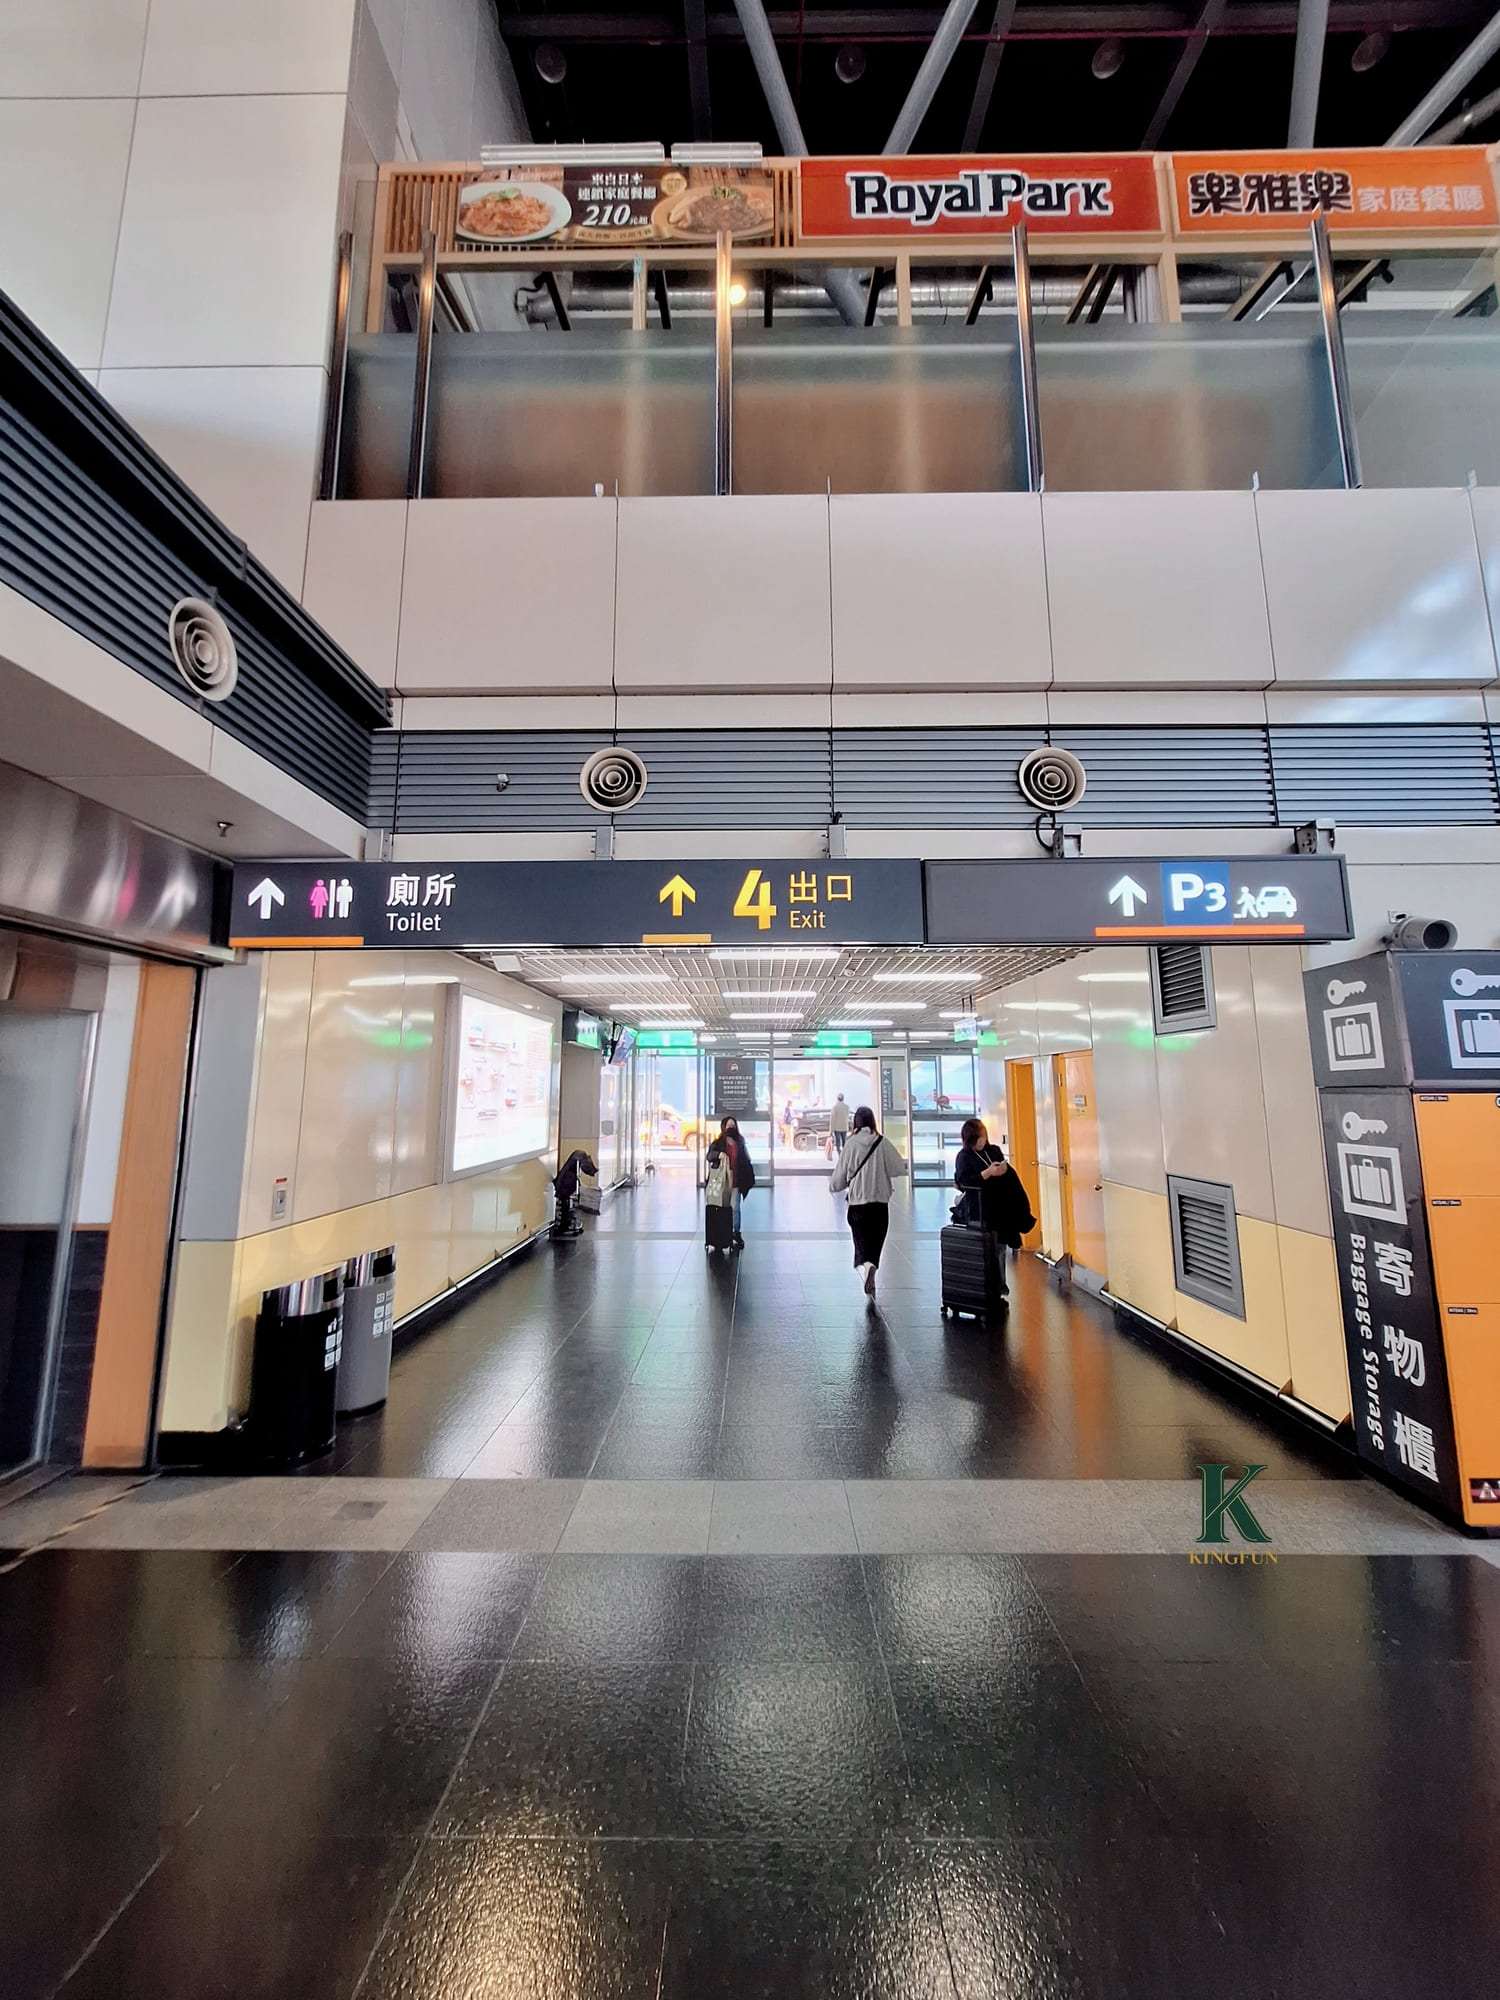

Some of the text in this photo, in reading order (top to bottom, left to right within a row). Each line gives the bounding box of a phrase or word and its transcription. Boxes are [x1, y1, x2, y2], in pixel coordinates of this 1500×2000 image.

[848, 172, 1111, 222] Royal Park
[1189, 170, 1484, 215] 樂雅樂 家庭餐廳
[386, 873, 457, 906] 廁所
[733, 869, 852, 930] 4 出口
[1171, 873, 1227, 912] P3
[386, 912, 442, 931] Toilet
[789, 909, 826, 929] Exit
[1350, 1233, 1385, 1451] Baggage Storage
[1373, 1241, 1440, 1483] 寄物櫃
